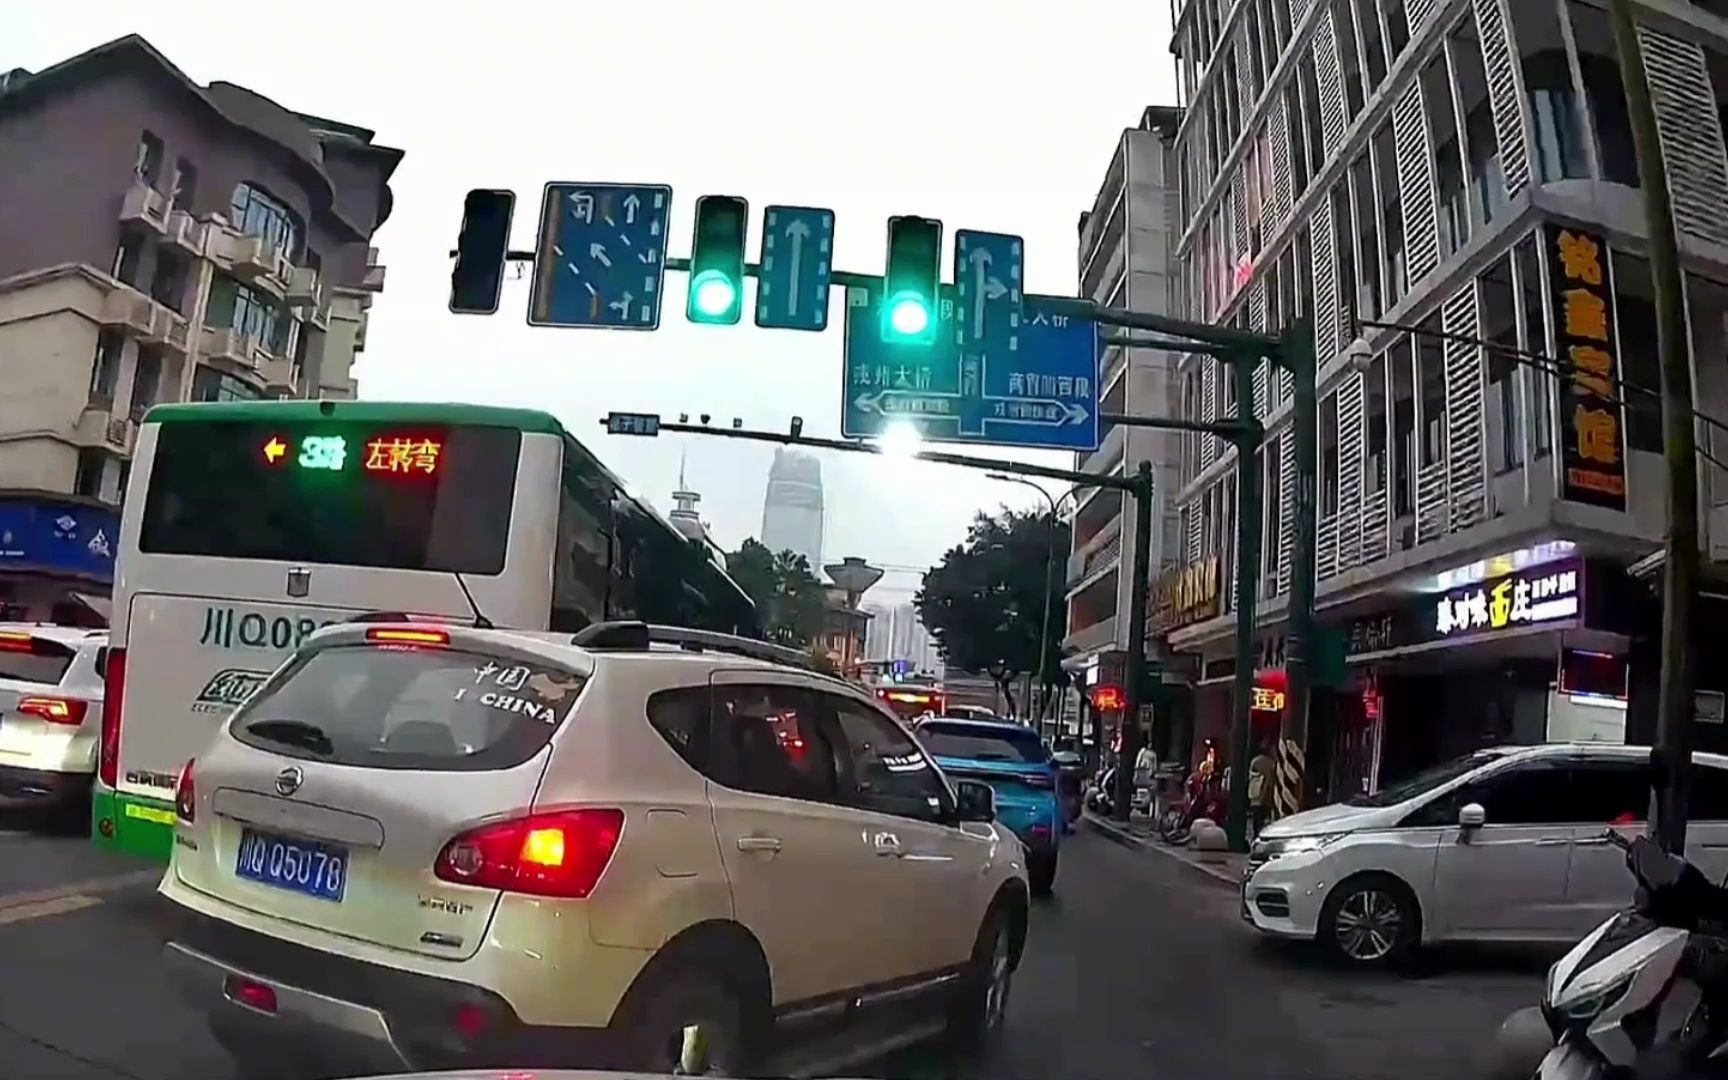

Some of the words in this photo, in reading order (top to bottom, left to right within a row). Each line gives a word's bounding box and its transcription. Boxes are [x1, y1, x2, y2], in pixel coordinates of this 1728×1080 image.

[366, 438, 441, 473] 左转弯
[474, 661, 530, 691] 中国
[480, 692, 555, 724] CHINA
